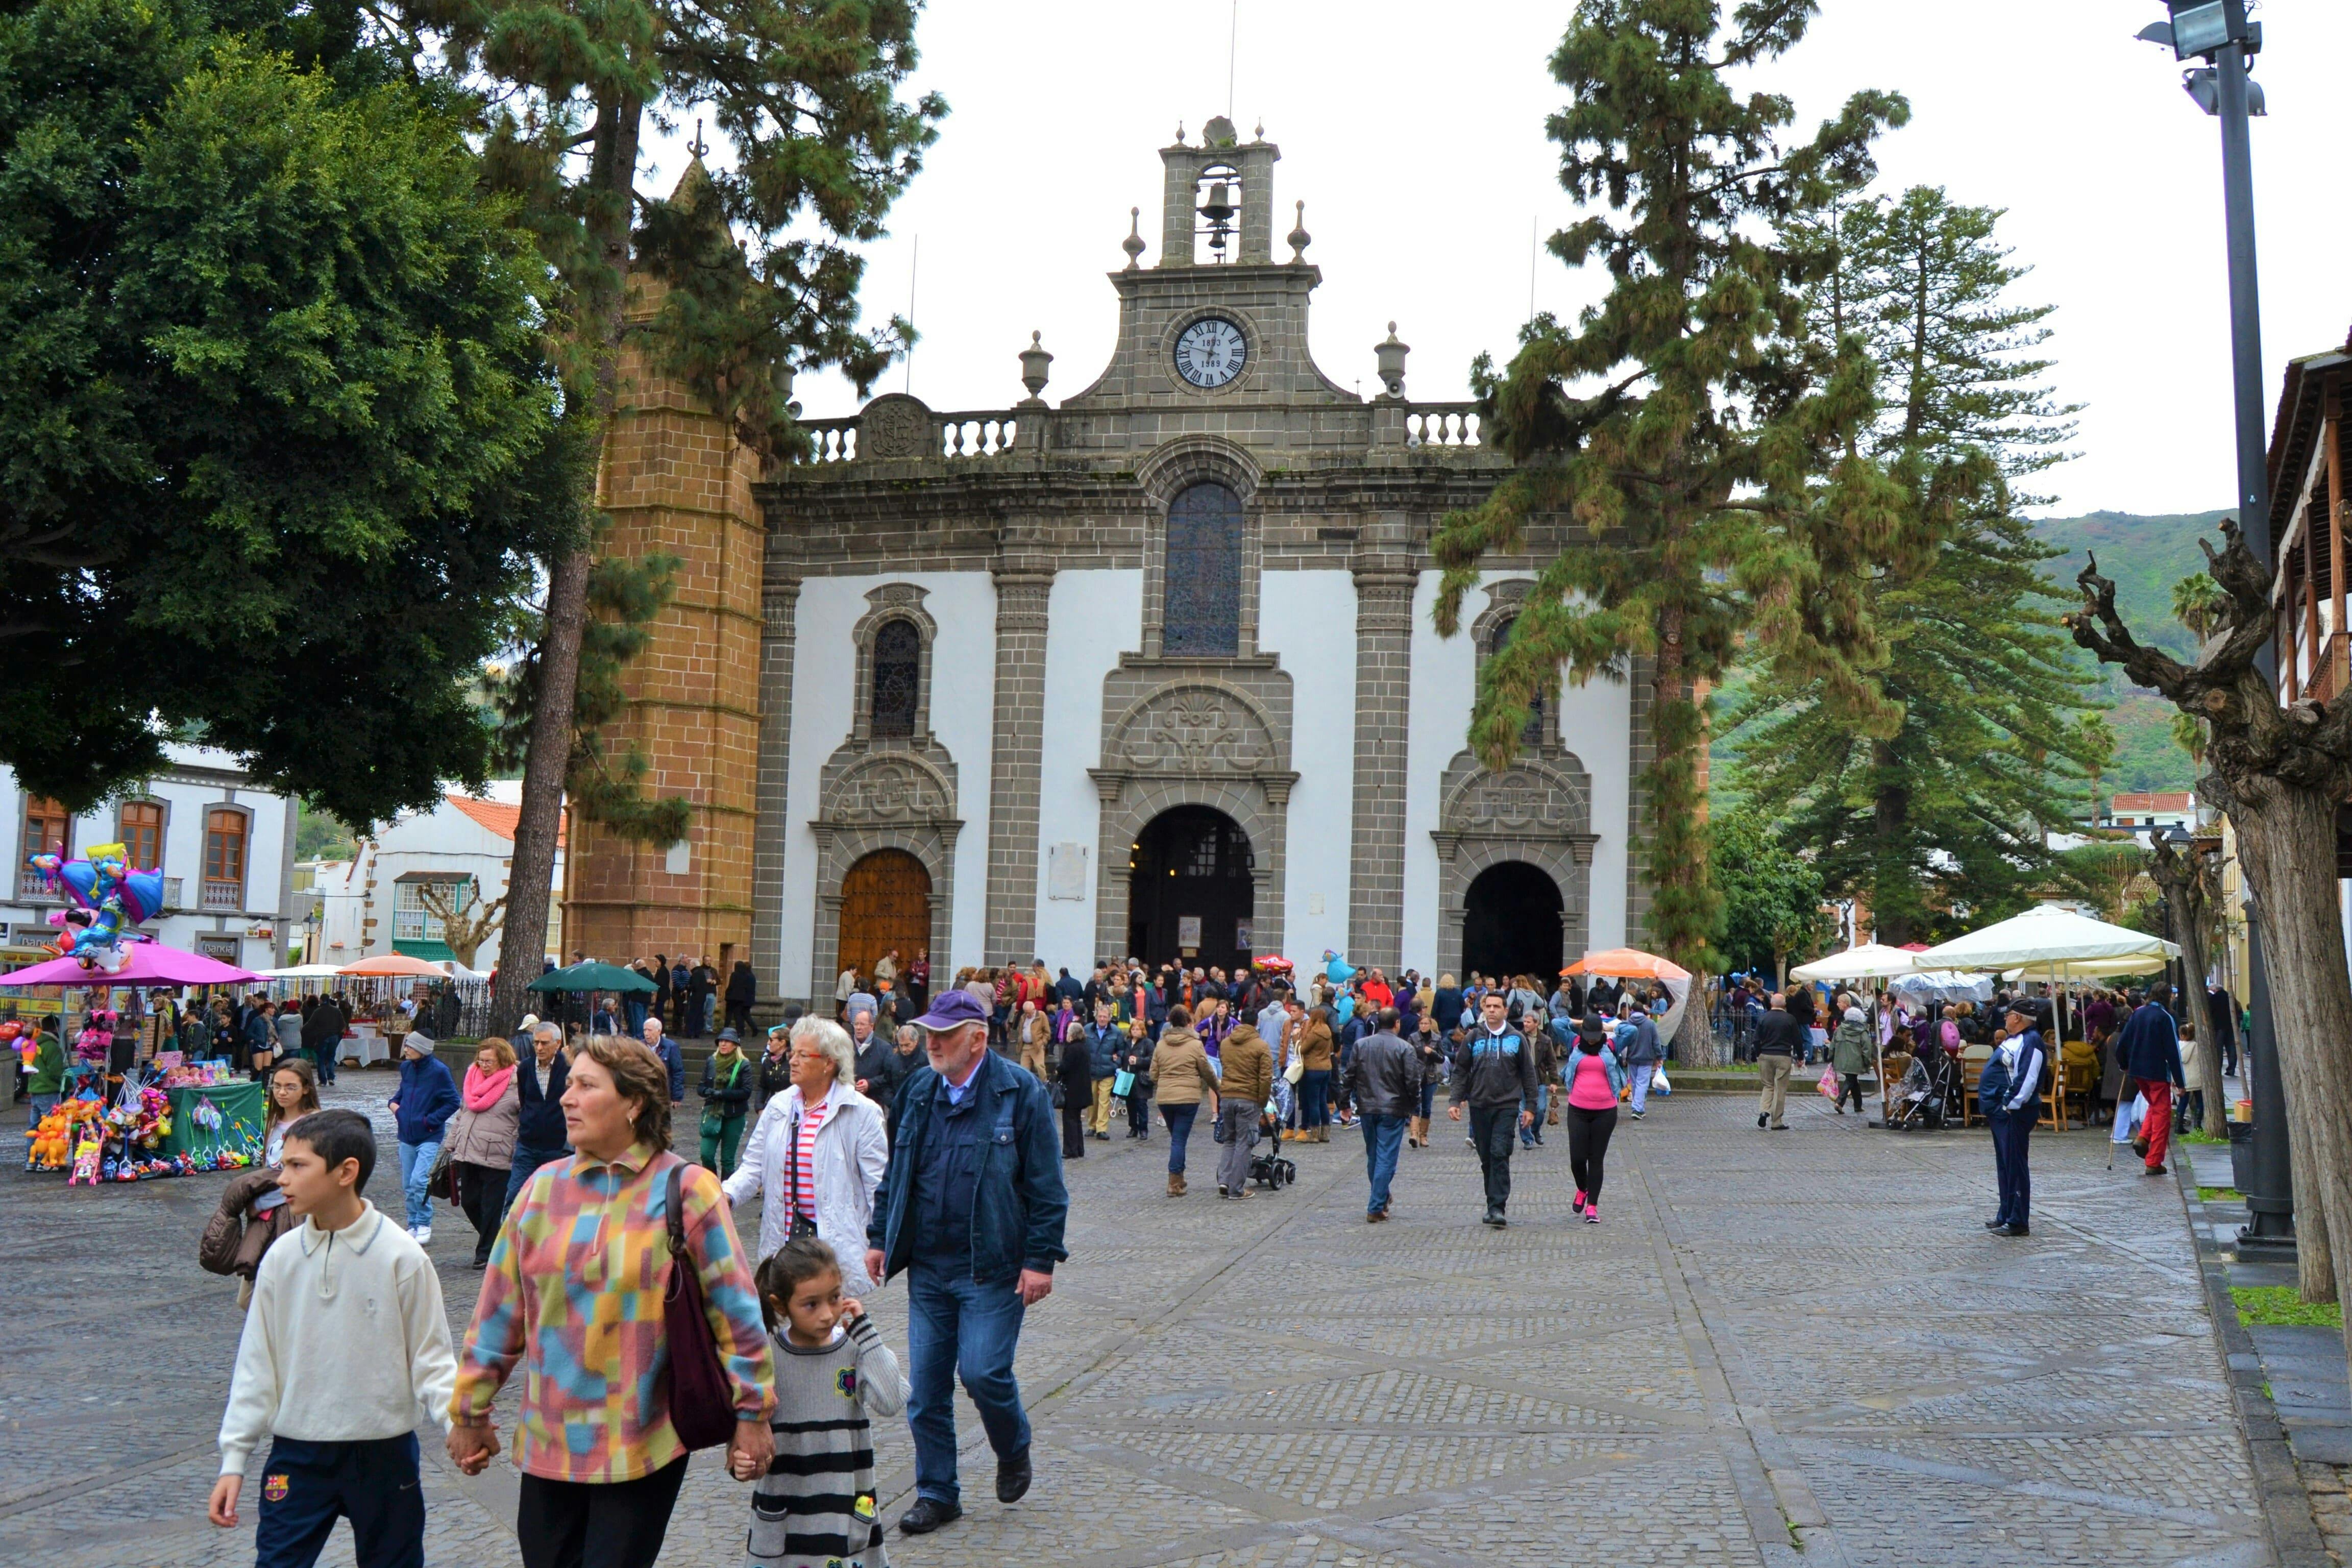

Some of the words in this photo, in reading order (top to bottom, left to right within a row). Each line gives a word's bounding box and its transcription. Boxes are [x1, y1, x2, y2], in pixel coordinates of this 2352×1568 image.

[1192, 324, 1204, 338] XI
[1206, 322, 1217, 333] XII
[1220, 325, 1229, 336] I
[1228, 334, 1241, 345] II
[1232, 348, 1243, 357] III
[1180, 360, 1194, 375] VIII
[1190, 369, 1202, 383] VII
[1205, 374, 1214, 385] VI
[21, 937, 56, 947] Bankia
[205, 945, 233, 953] Bankia
